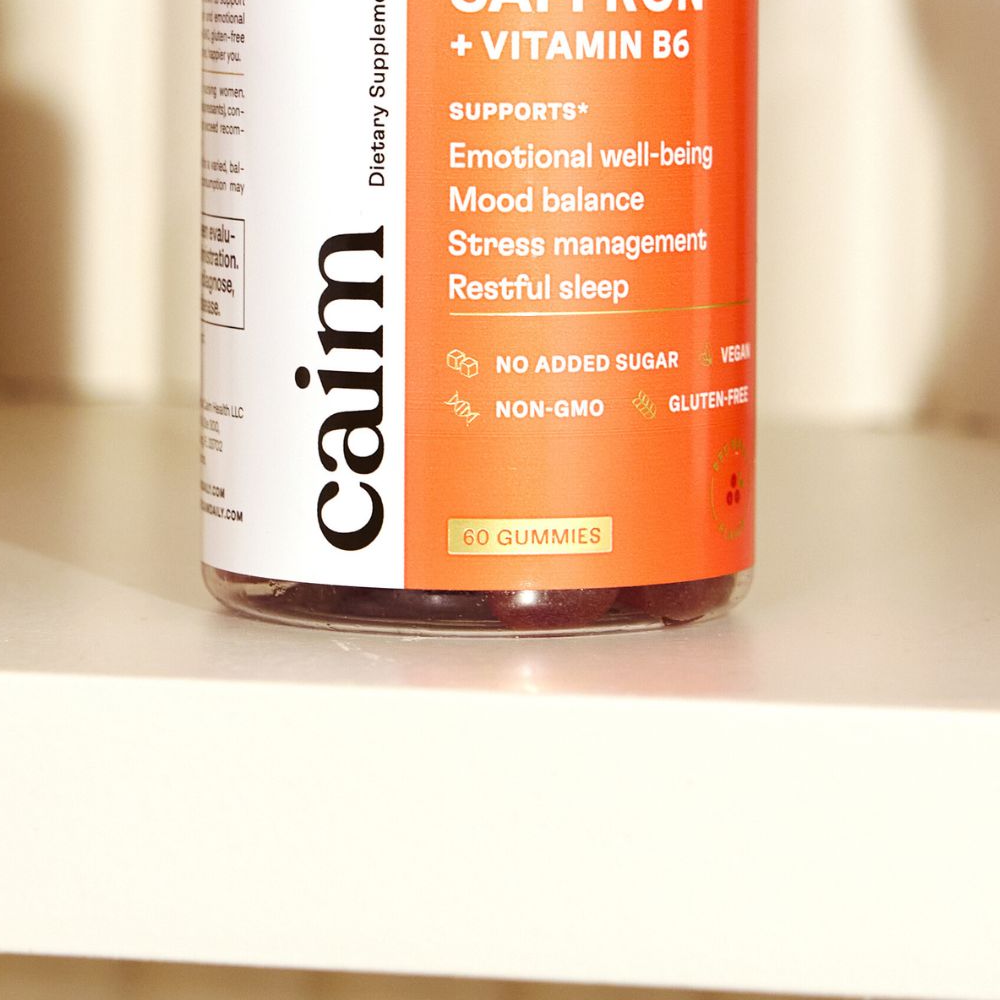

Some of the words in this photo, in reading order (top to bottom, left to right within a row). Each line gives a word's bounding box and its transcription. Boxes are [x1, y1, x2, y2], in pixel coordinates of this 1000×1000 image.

[214, 12, 246, 26] emotional
[481, 30, 642, 60] VITAMIN
[653, 29, 690, 59] B6
[228, 106, 245, 117] con-
[368, 105, 389, 187] Dietary
[449, 142, 593, 169] Emotional
[599, 140, 713, 170] well-being
[229, 183, 245, 196] may
[449, 185, 534, 213] Mood
[542, 185, 645, 213] balance
[209, 223, 236, 244] evalu-
[448, 229, 546, 258] Stress
[553, 229, 707, 260] management
[449, 273, 551, 300] Restful
[559, 273, 629, 304] sleep
[496, 355, 529, 374] NO
[534, 354, 610, 374] ADDED
[615, 351, 679, 372] SUGAR
[720, 343, 752, 364] VEGAN
[294, 225, 385, 552] caim
[668, 385, 749, 413] GLUTEN-FREE
[231, 406, 244, 419] LLC
[495, 398, 604, 419] NON-GMO
[463, 529, 490, 546] 60
[497, 527, 601, 546] GUMMIES
